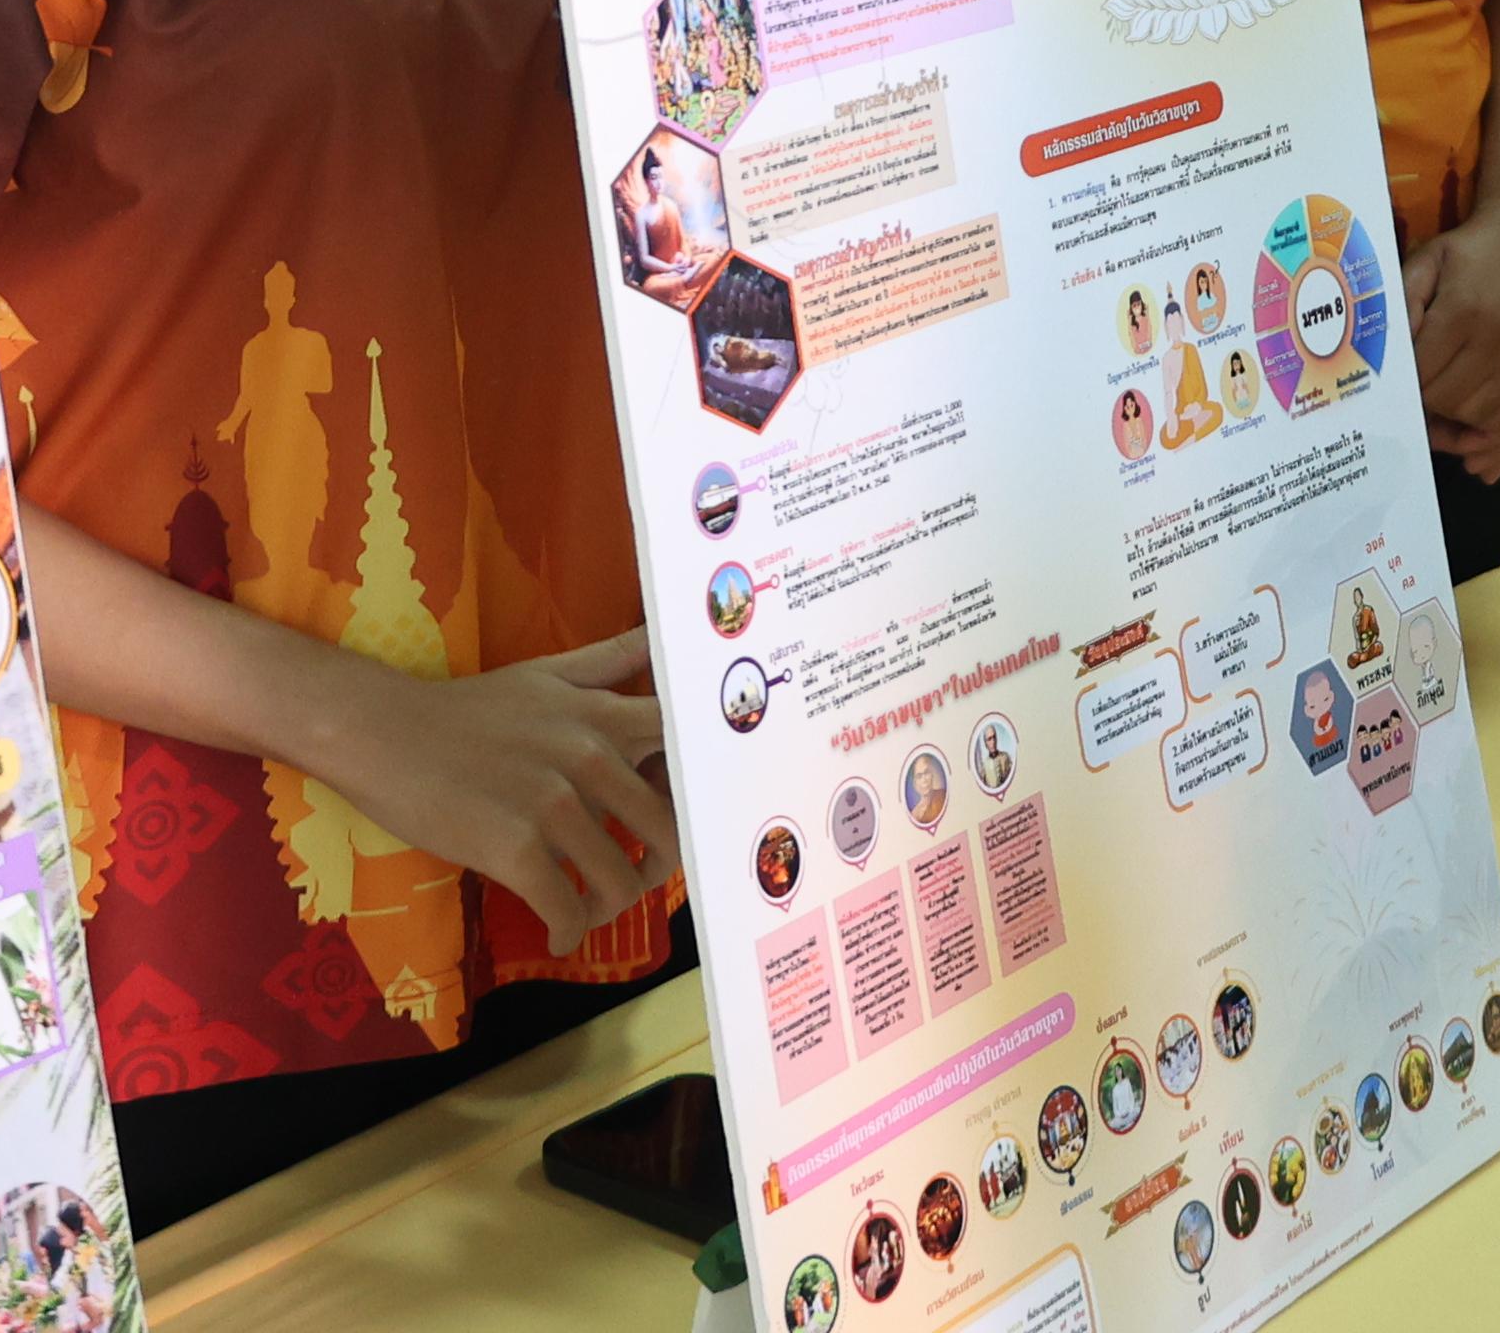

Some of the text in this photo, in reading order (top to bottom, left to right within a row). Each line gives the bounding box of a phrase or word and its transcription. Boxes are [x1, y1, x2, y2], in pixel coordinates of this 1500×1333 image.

[1043, 99, 1201, 161] หลักธรรมสำคัญในวันวิสาขบูชา
[1049, 197, 1057, 208] 1.
[1109, 176, 1121, 190] คือ
[1061, 280, 1070, 291] 2.
[1105, 260, 1117, 275] คือ
[1117, 237, 1190, 274] ความจริงอันประเสริฐ
[1190, 236, 1196, 247] 4
[1196, 225, 1223, 244] ประการ
[1301, 297, 1344, 329] มรรค 8
[1124, 533, 1131, 545] 3.
[1134, 507, 1191, 539] ความไม่ประมาท
[1194, 499, 1205, 513] คือ
[1324, 435, 1350, 460] พูดอะไร
[1352, 429, 1363, 446] คิด
[1126, 546, 1145, 563] อะไร
[1365, 533, 1386, 555] องค์
[1388, 555, 1403, 574] บุค
[1132, 582, 1158, 602] ตามมา
[1402, 575, 1416, 591] คล
[1222, 659, 1246, 678] ศาสนา
[1356, 657, 1393, 691] พระสงฆ์
[1416, 679, 1446, 710] ภิกษุณี
[1308, 740, 1345, 769] สามเณร
[1178, 752, 1246, 794] ครอบครัวและชุมชน
[1219, 1129, 1245, 1156] เทียน
[850, 1169, 885, 1197] ไหว้พระ
[1198, 1286, 1213, 1313] ธูป
